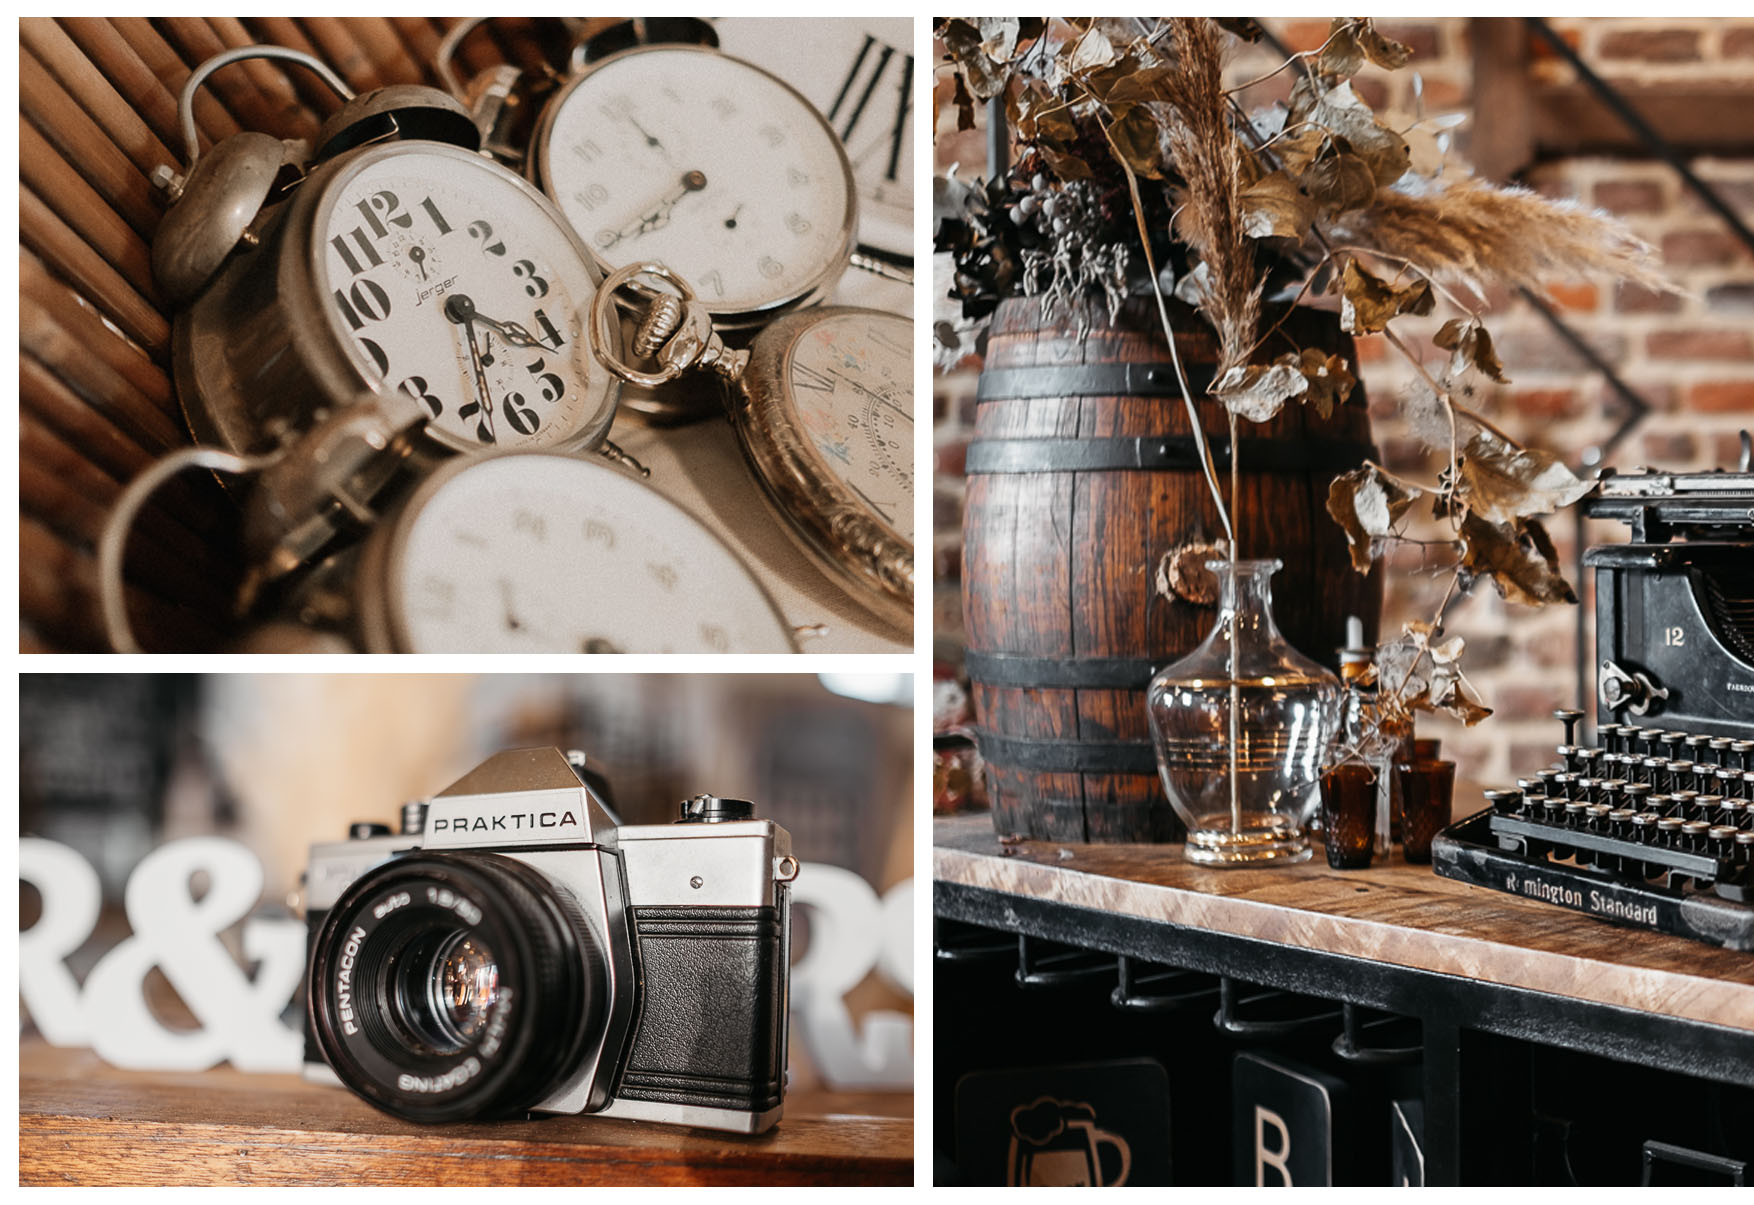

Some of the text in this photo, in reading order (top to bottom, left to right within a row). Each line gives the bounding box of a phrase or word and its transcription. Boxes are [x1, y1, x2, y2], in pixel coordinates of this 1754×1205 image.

[353, 190, 413, 240] 12
[421, 196, 457, 237] 1
[330, 226, 388, 276] 11
[467, 219, 506, 257] 2
[415, 275, 458, 307] jerger
[512, 259, 549, 298] 3
[334, 278, 391, 331] 10
[533, 308, 566, 349] 4
[525, 357, 565, 403] 5
[503, 391, 540, 435] 6
[1665, 626, 1686, 646] 12
[434, 810, 577, 833] PRAKTICA
[1506, 872, 1658, 925] Rmington Standard
[337, 926, 367, 1036] PENTACON
